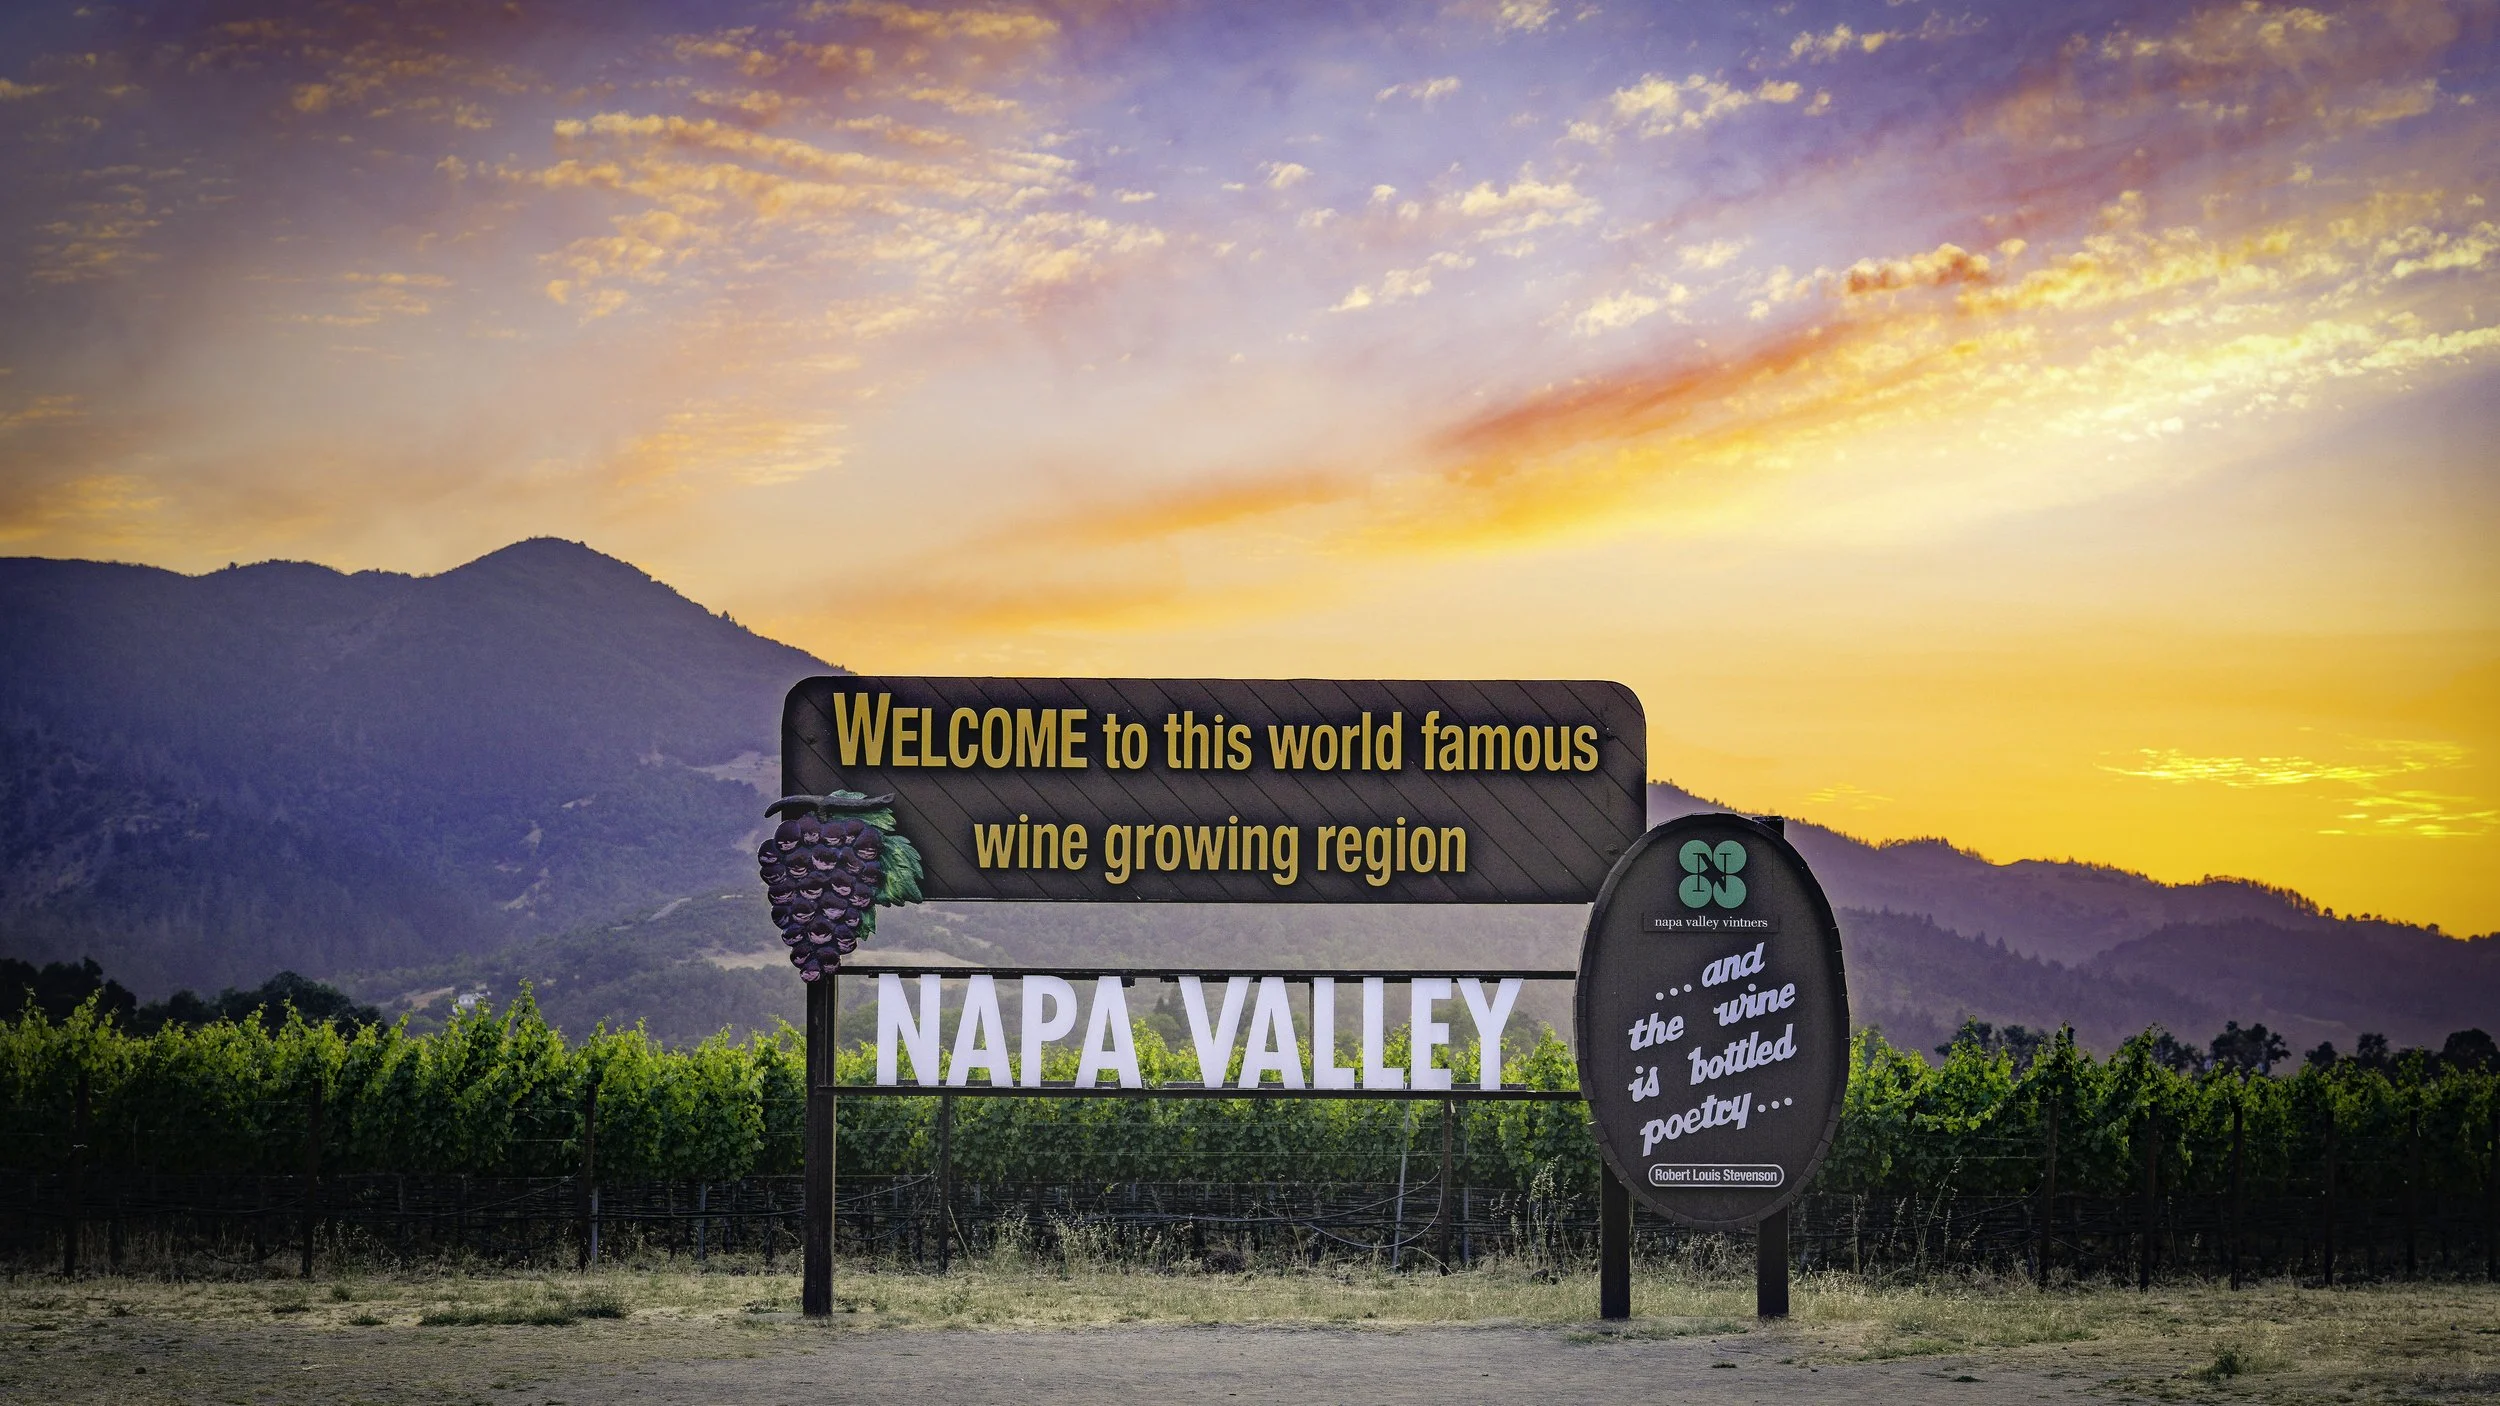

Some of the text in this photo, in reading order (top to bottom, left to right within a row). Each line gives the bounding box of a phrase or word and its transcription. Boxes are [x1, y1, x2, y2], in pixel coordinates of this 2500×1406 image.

[833, 692, 1599, 772] WELCOME to this world famous
[974, 814, 1467, 887] wine growing region
[1654, 916, 1768, 930] napa valley vintners
[876, 974, 1525, 1090] NAPA VALLEY
[1628, 983, 1796, 1051] the wine
[1628, 1023, 1797, 1103] is bottled
[1655, 1169, 1778, 1182] Robert Louis Stevenson
